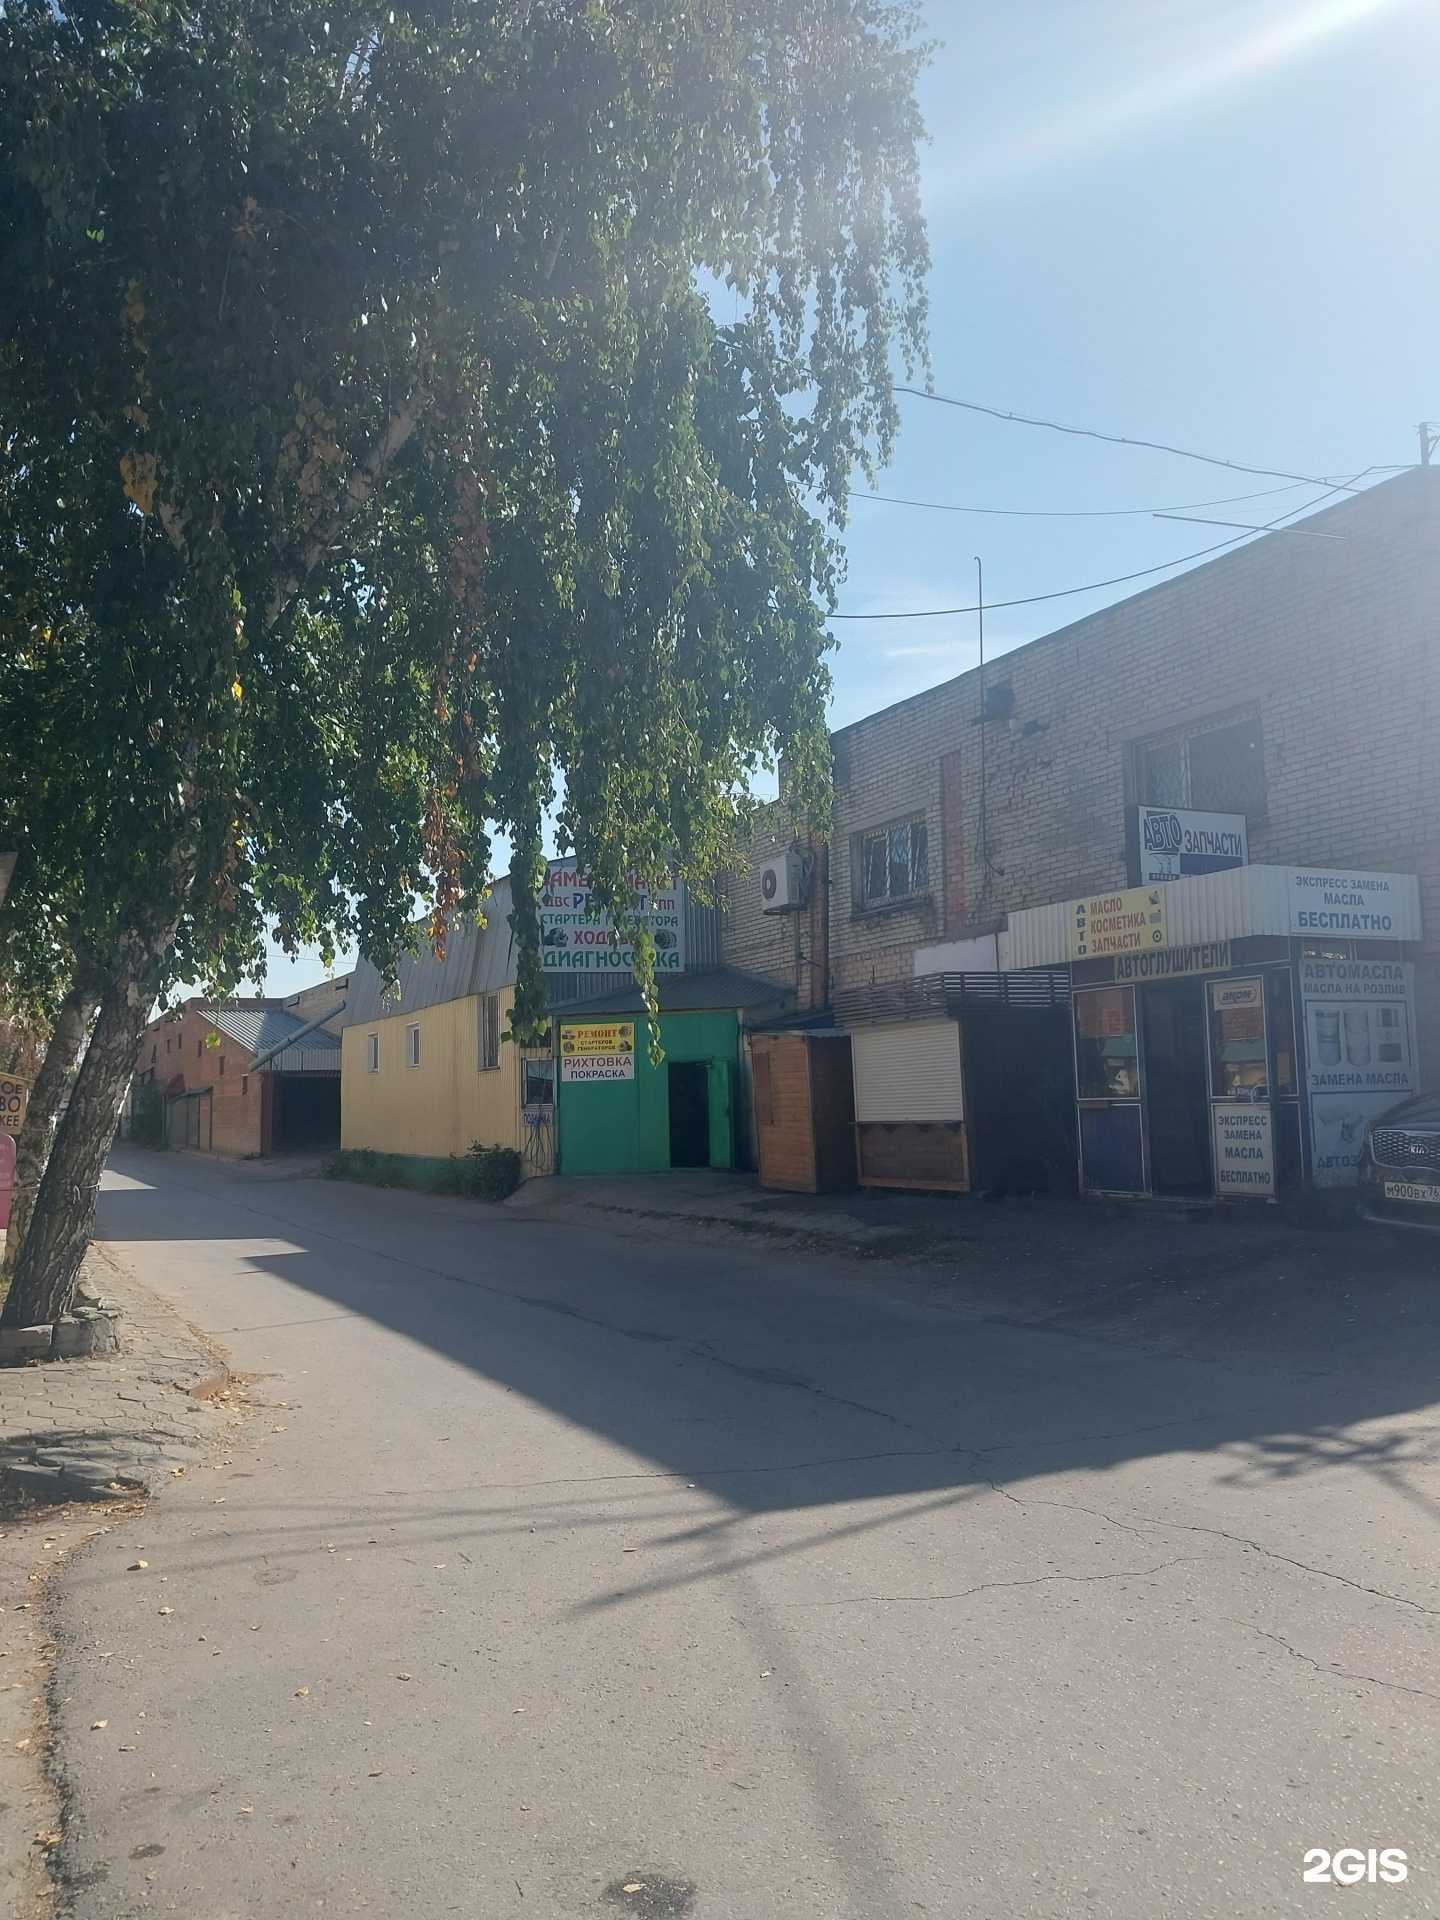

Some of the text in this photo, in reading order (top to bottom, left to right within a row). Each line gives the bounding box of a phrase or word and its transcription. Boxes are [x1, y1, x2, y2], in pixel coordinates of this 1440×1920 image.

[1144, 814, 1243, 856] АВТО ЗАПЧАСТИ
[1295, 876, 1390, 891] ЭКСПРЕСС ЗАМЕНА
[1089, 897, 1122, 915] МАСЛО
[1324, 892, 1365, 906] МАСЛА
[1090, 912, 1146, 934] КОСМЕТИКА
[1298, 911, 1392, 931] БЕСПЛАТНО
[1091, 932, 1141, 953] ЗАПЧАСТИ
[543, 951, 680, 969] ДИАГНОСКА
[1117, 942, 1230, 979] АВТОГЛУШИТЕЛИ
[1303, 962, 1404, 981] АВТОМАСЛА
[1303, 982, 1343, 995] МАСЛА
[1345, 983, 1362, 995] НА
[577, 1029, 618, 1039] РЕМОНТ
[564, 1056, 632, 1069] РИХТОВКА
[570, 1069, 626, 1080] ПОКРАСКА
[1311, 1072, 1409, 1087] ЗАМЕНА МАСЛА
[1218, 1115, 1268, 1127] ЭКСПРЕСС
[1224, 1130, 1263, 1141] ЗАМЕНА
[1225, 1147, 1264, 1160] МАСЛА
[1220, 1170, 1271, 1185] БЕСПЛАТНО
